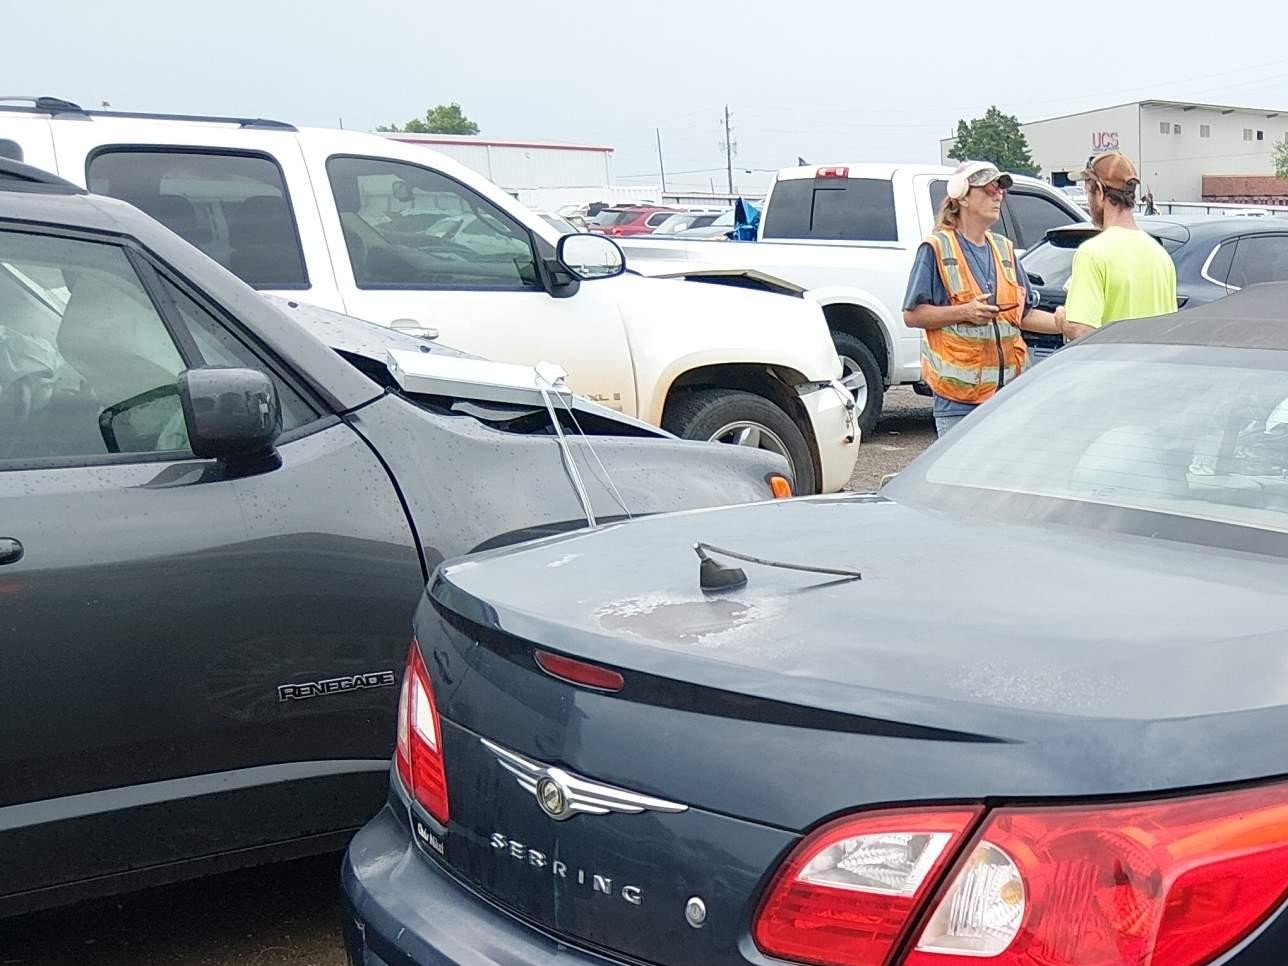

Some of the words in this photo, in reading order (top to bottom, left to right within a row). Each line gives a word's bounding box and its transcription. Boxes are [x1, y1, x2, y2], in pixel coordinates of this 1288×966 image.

[1091, 131, 1119, 148] UCS
[277, 670, 395, 702] RENEGADE
[490, 832, 643, 906] SEBRING
